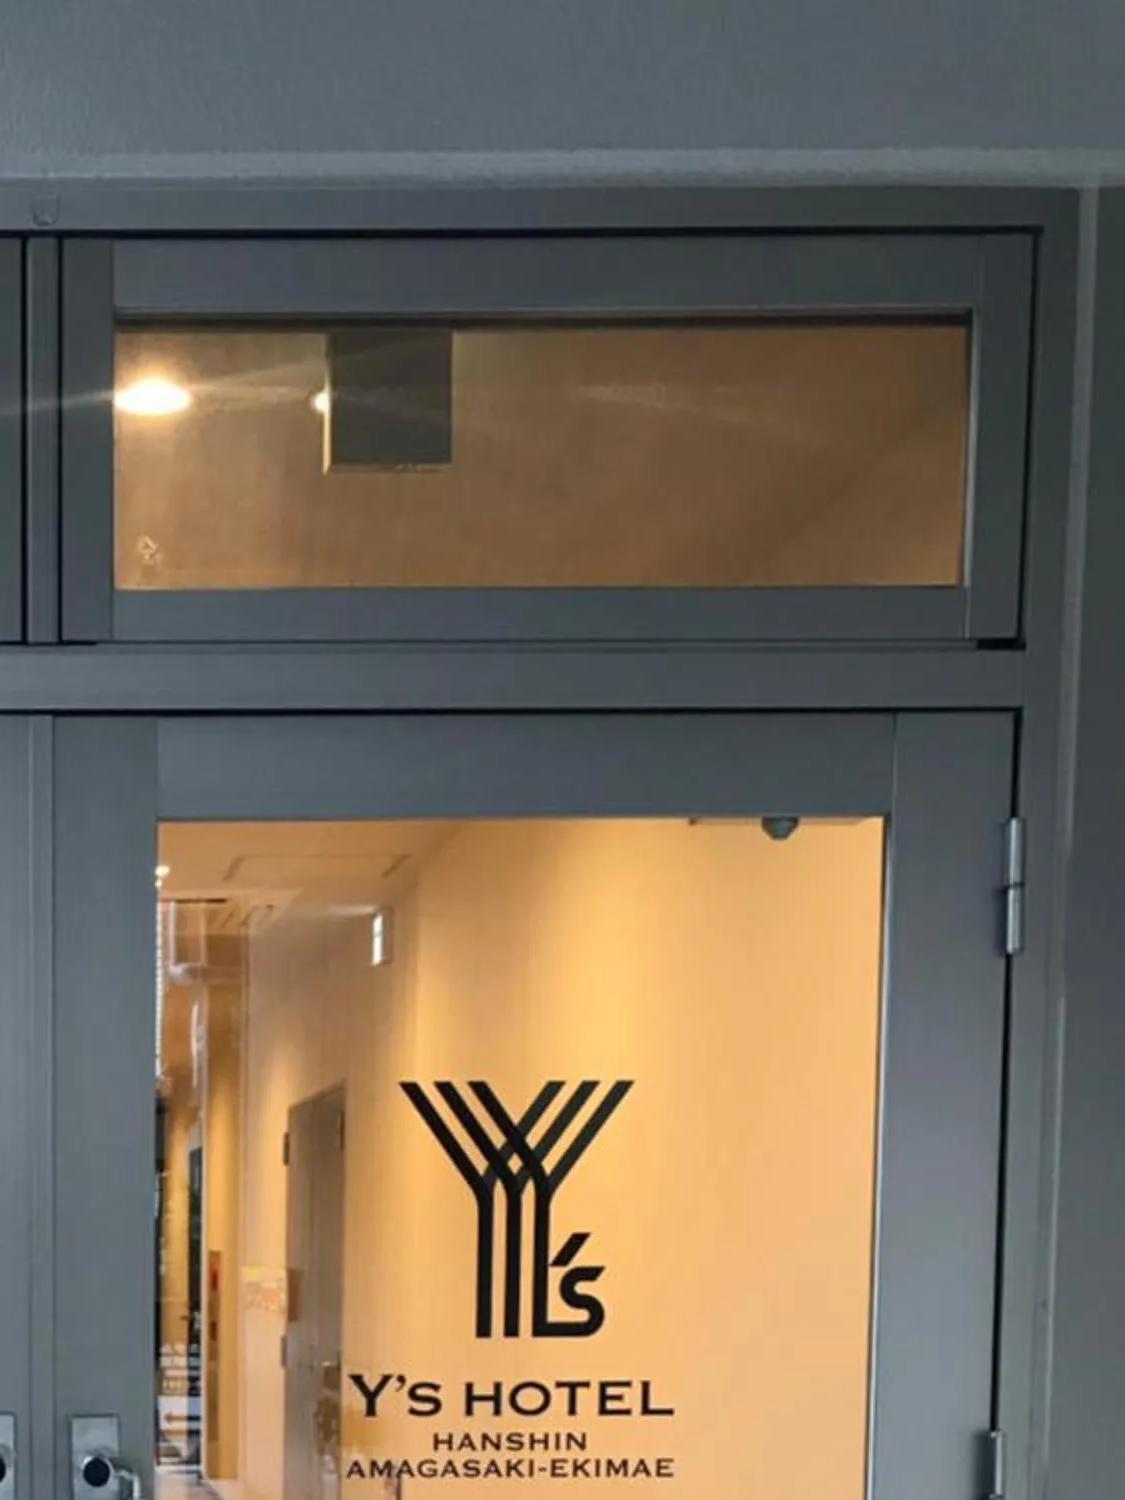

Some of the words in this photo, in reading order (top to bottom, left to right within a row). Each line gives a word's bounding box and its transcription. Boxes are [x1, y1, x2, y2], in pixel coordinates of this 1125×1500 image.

[464, 1380, 675, 1417] HOTEL
[432, 1432, 587, 1452] HANSHIN
[346, 1458, 675, 1479] AMAGASAKI-EKIMAE
